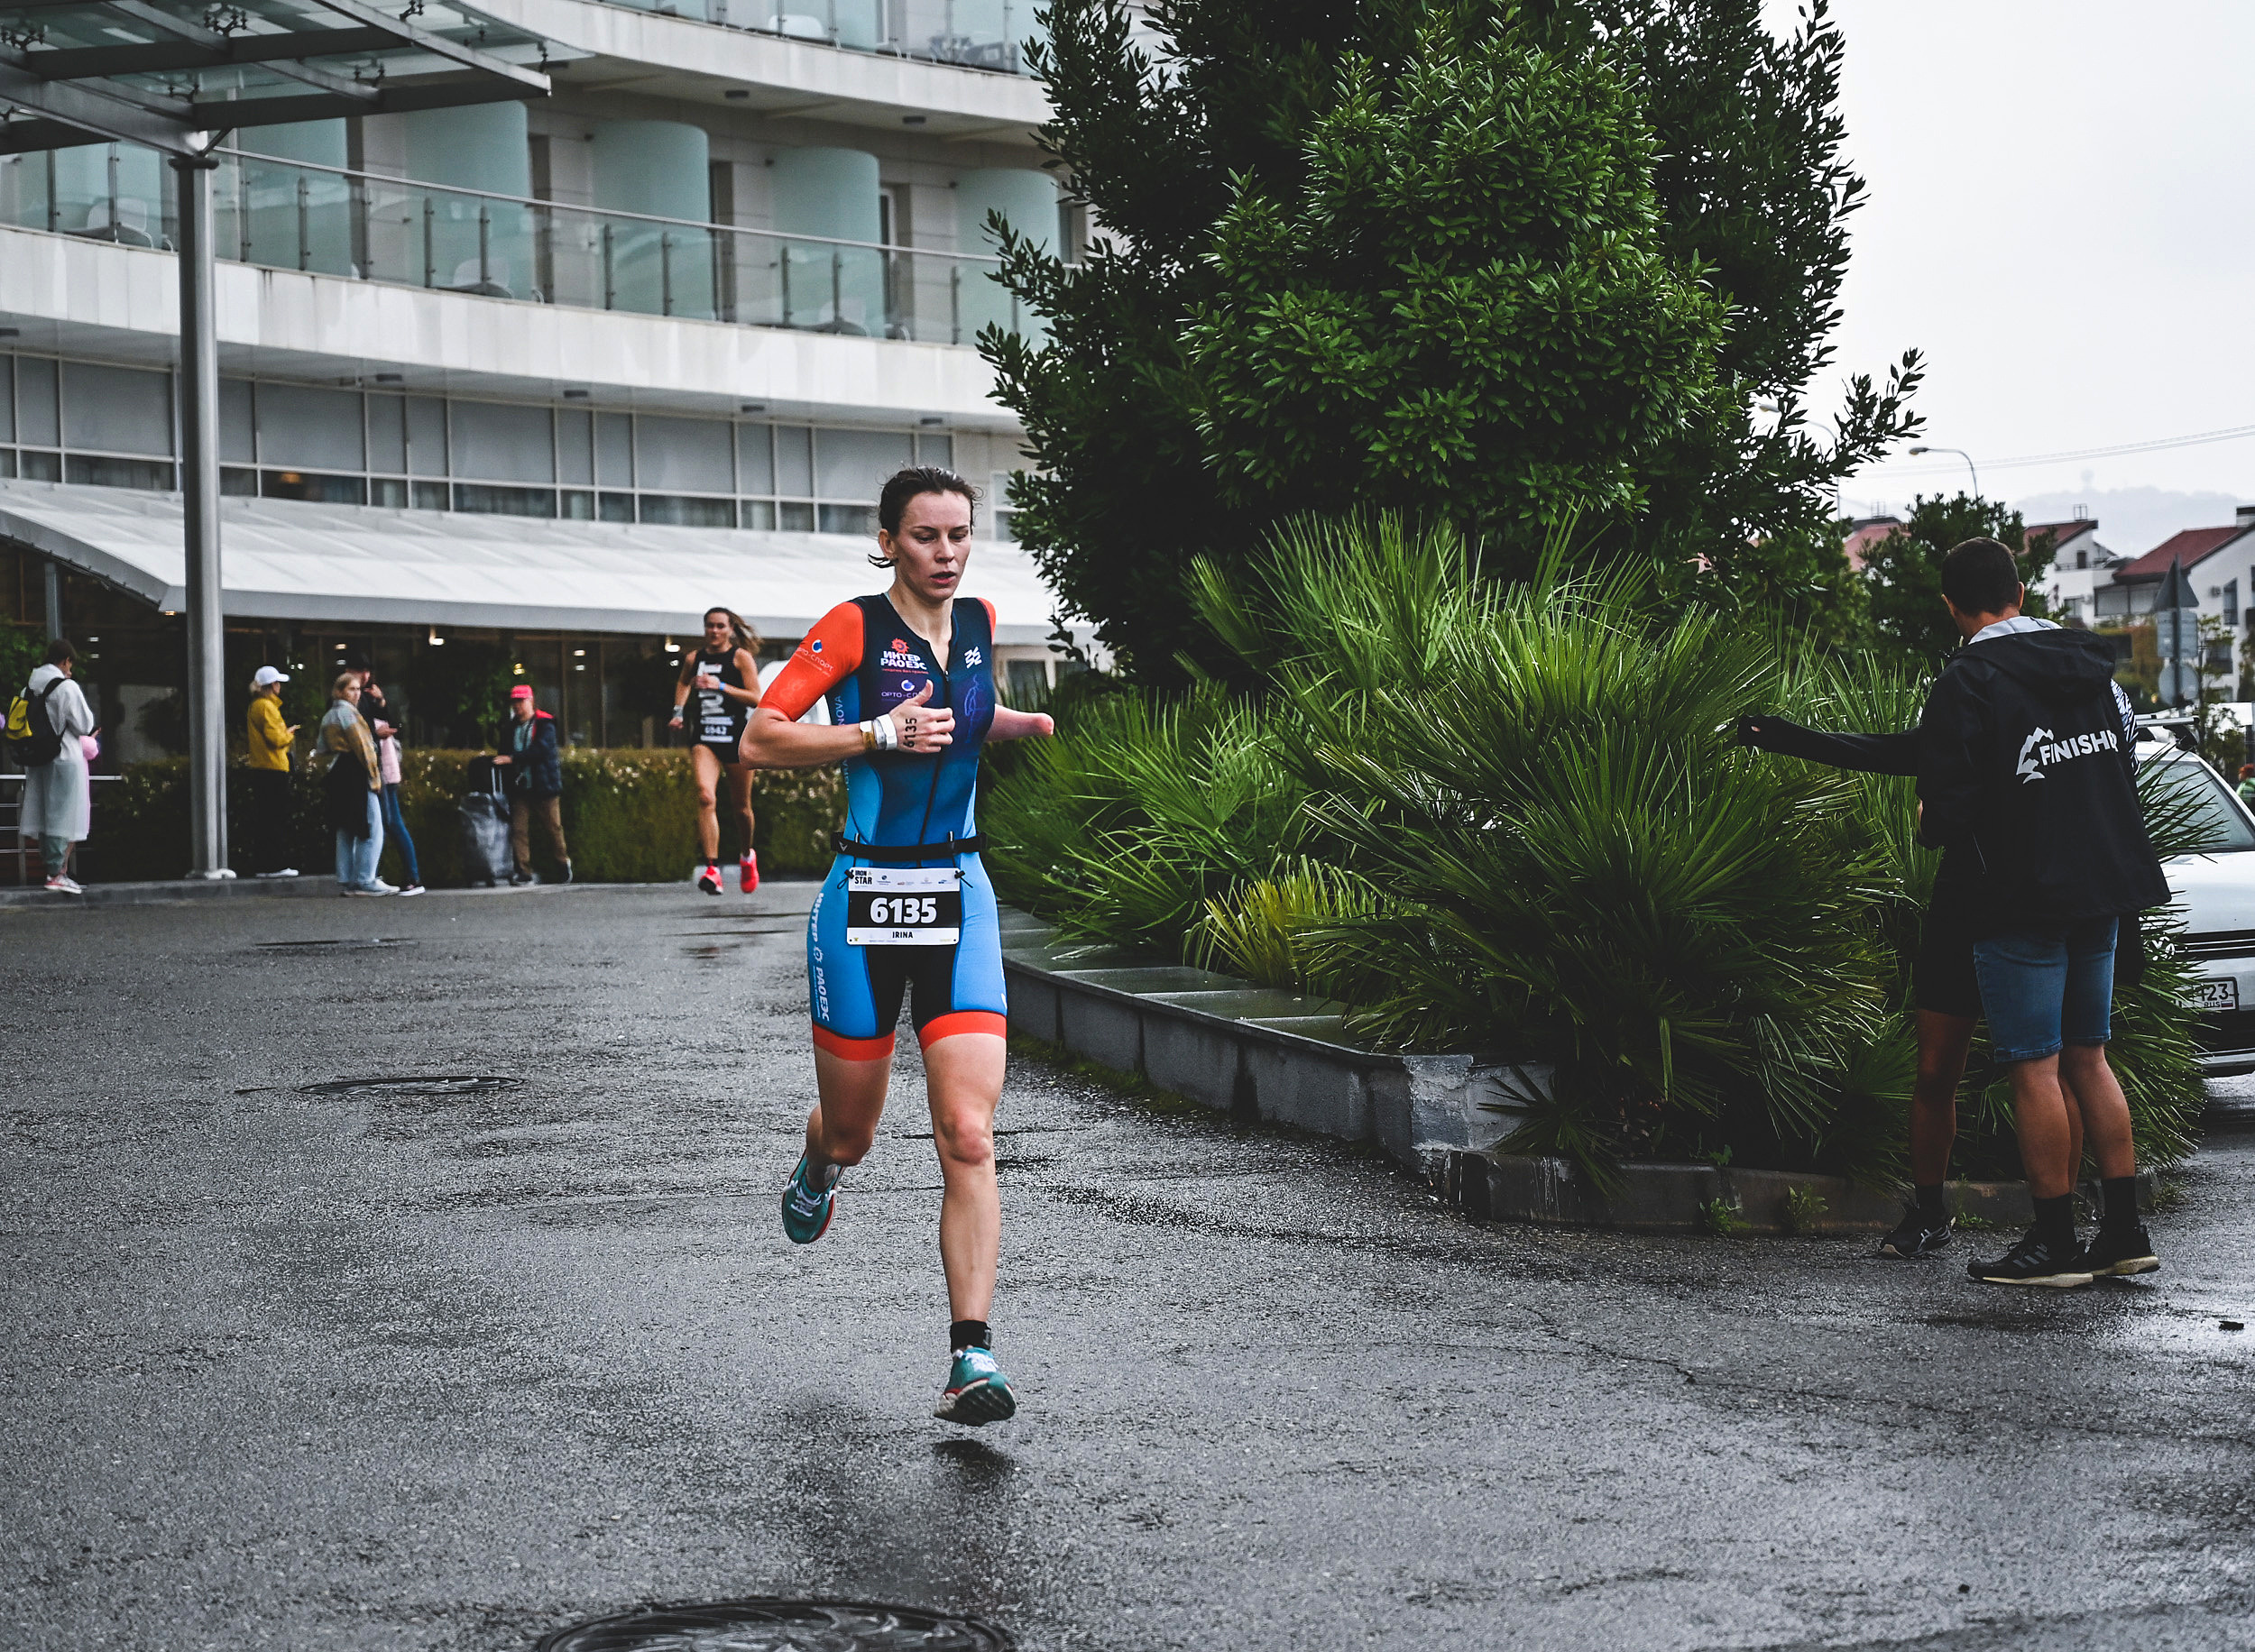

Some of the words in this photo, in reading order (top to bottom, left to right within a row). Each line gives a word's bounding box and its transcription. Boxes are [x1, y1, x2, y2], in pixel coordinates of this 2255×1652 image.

[903, 718, 917, 748] 6135
[854, 876, 872, 885] STAR
[870, 897, 937, 924] 6135
